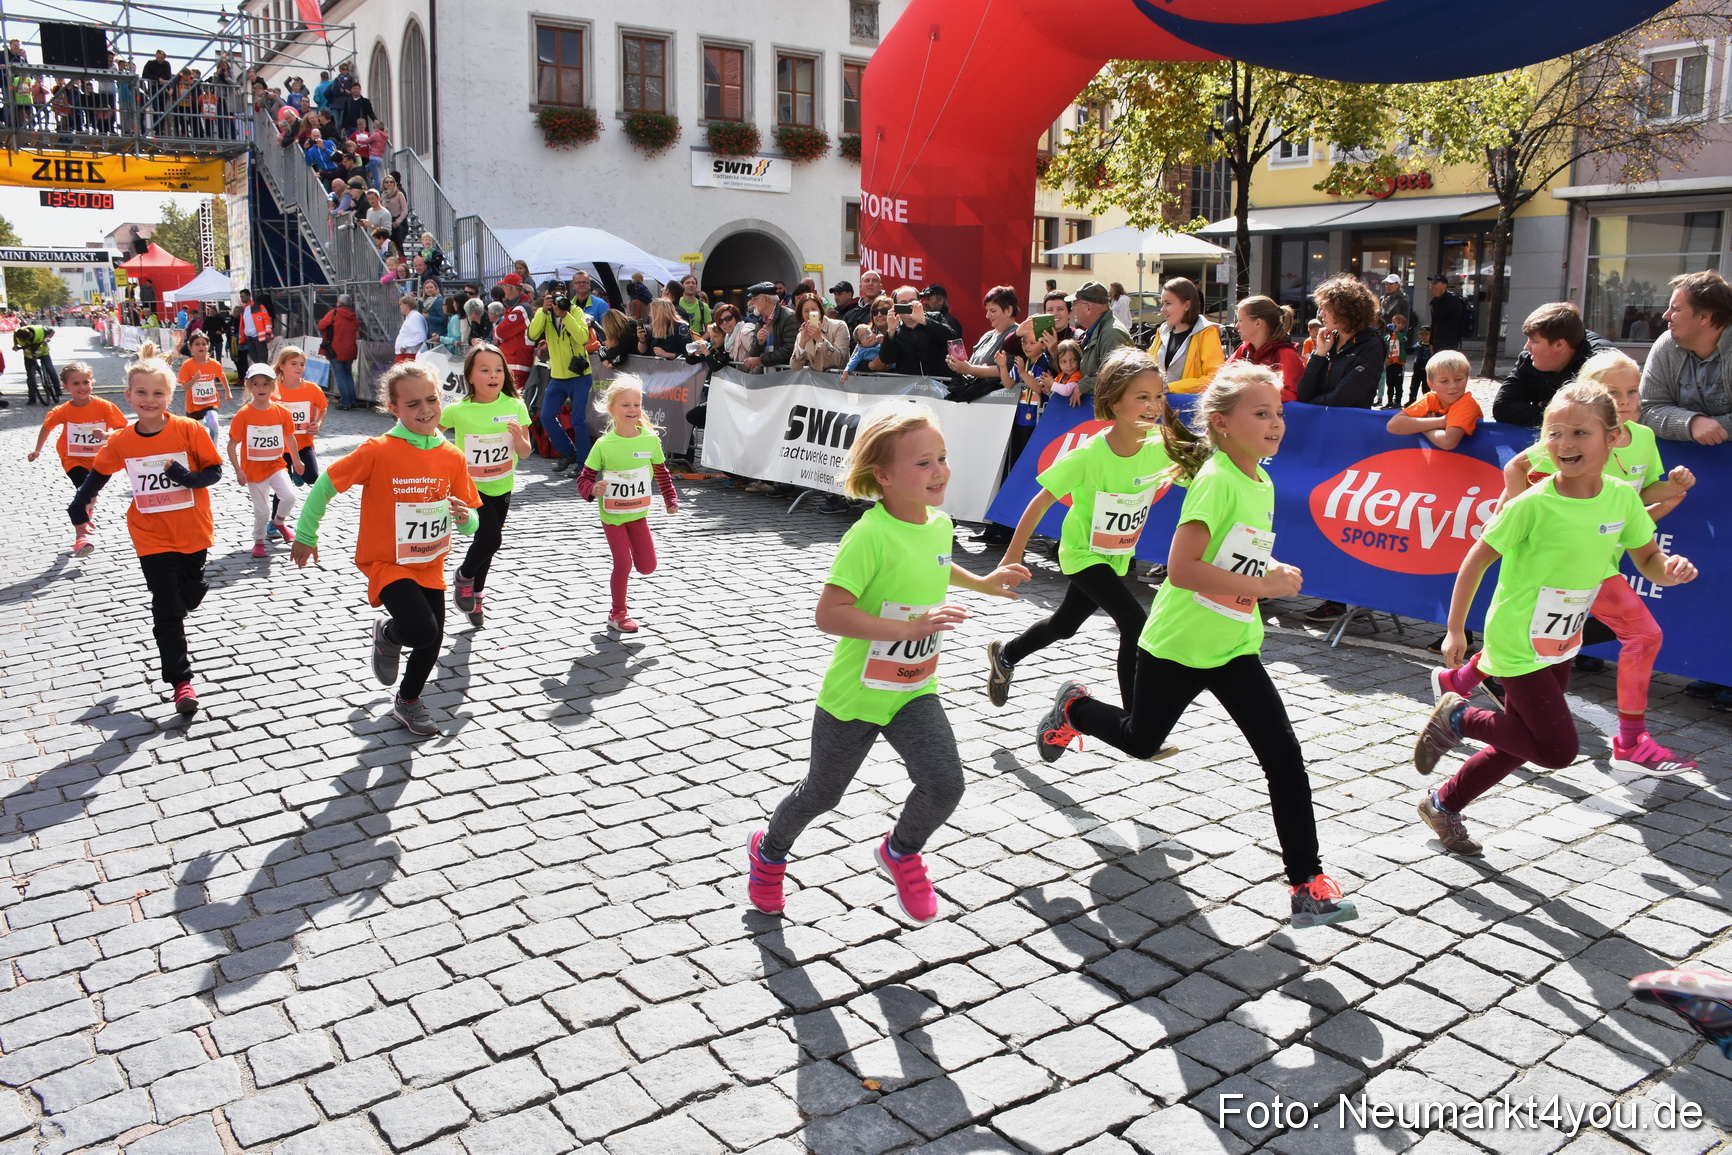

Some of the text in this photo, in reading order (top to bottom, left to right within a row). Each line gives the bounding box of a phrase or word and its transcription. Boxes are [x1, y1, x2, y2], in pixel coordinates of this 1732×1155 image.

[32, 158, 105, 183] ZIEL
[713, 160, 753, 175] swn
[92, 194, 112, 209] 08
[0, 251, 99, 261] MINI NEUMARKT.
[442, 372, 467, 395] sw
[196, 388, 214, 396] 7043
[648, 386, 689, 402] LOUNGE
[784, 405, 861, 450] swn
[253, 435, 279, 447] 7258
[473, 446, 509, 464] 7122
[392, 477, 437, 485] Neumarkter
[611, 481, 645, 497] 7014
[393, 485, 428, 494] Stadtlauf
[149, 495, 171, 506] EVA
[1323, 469, 1500, 550] Hervis
[1105, 505, 1148, 531] 7059
[406, 516, 448, 539] 7154
[1341, 527, 1410, 553] SPORTS
[1236, 596, 1253, 607] Leni
